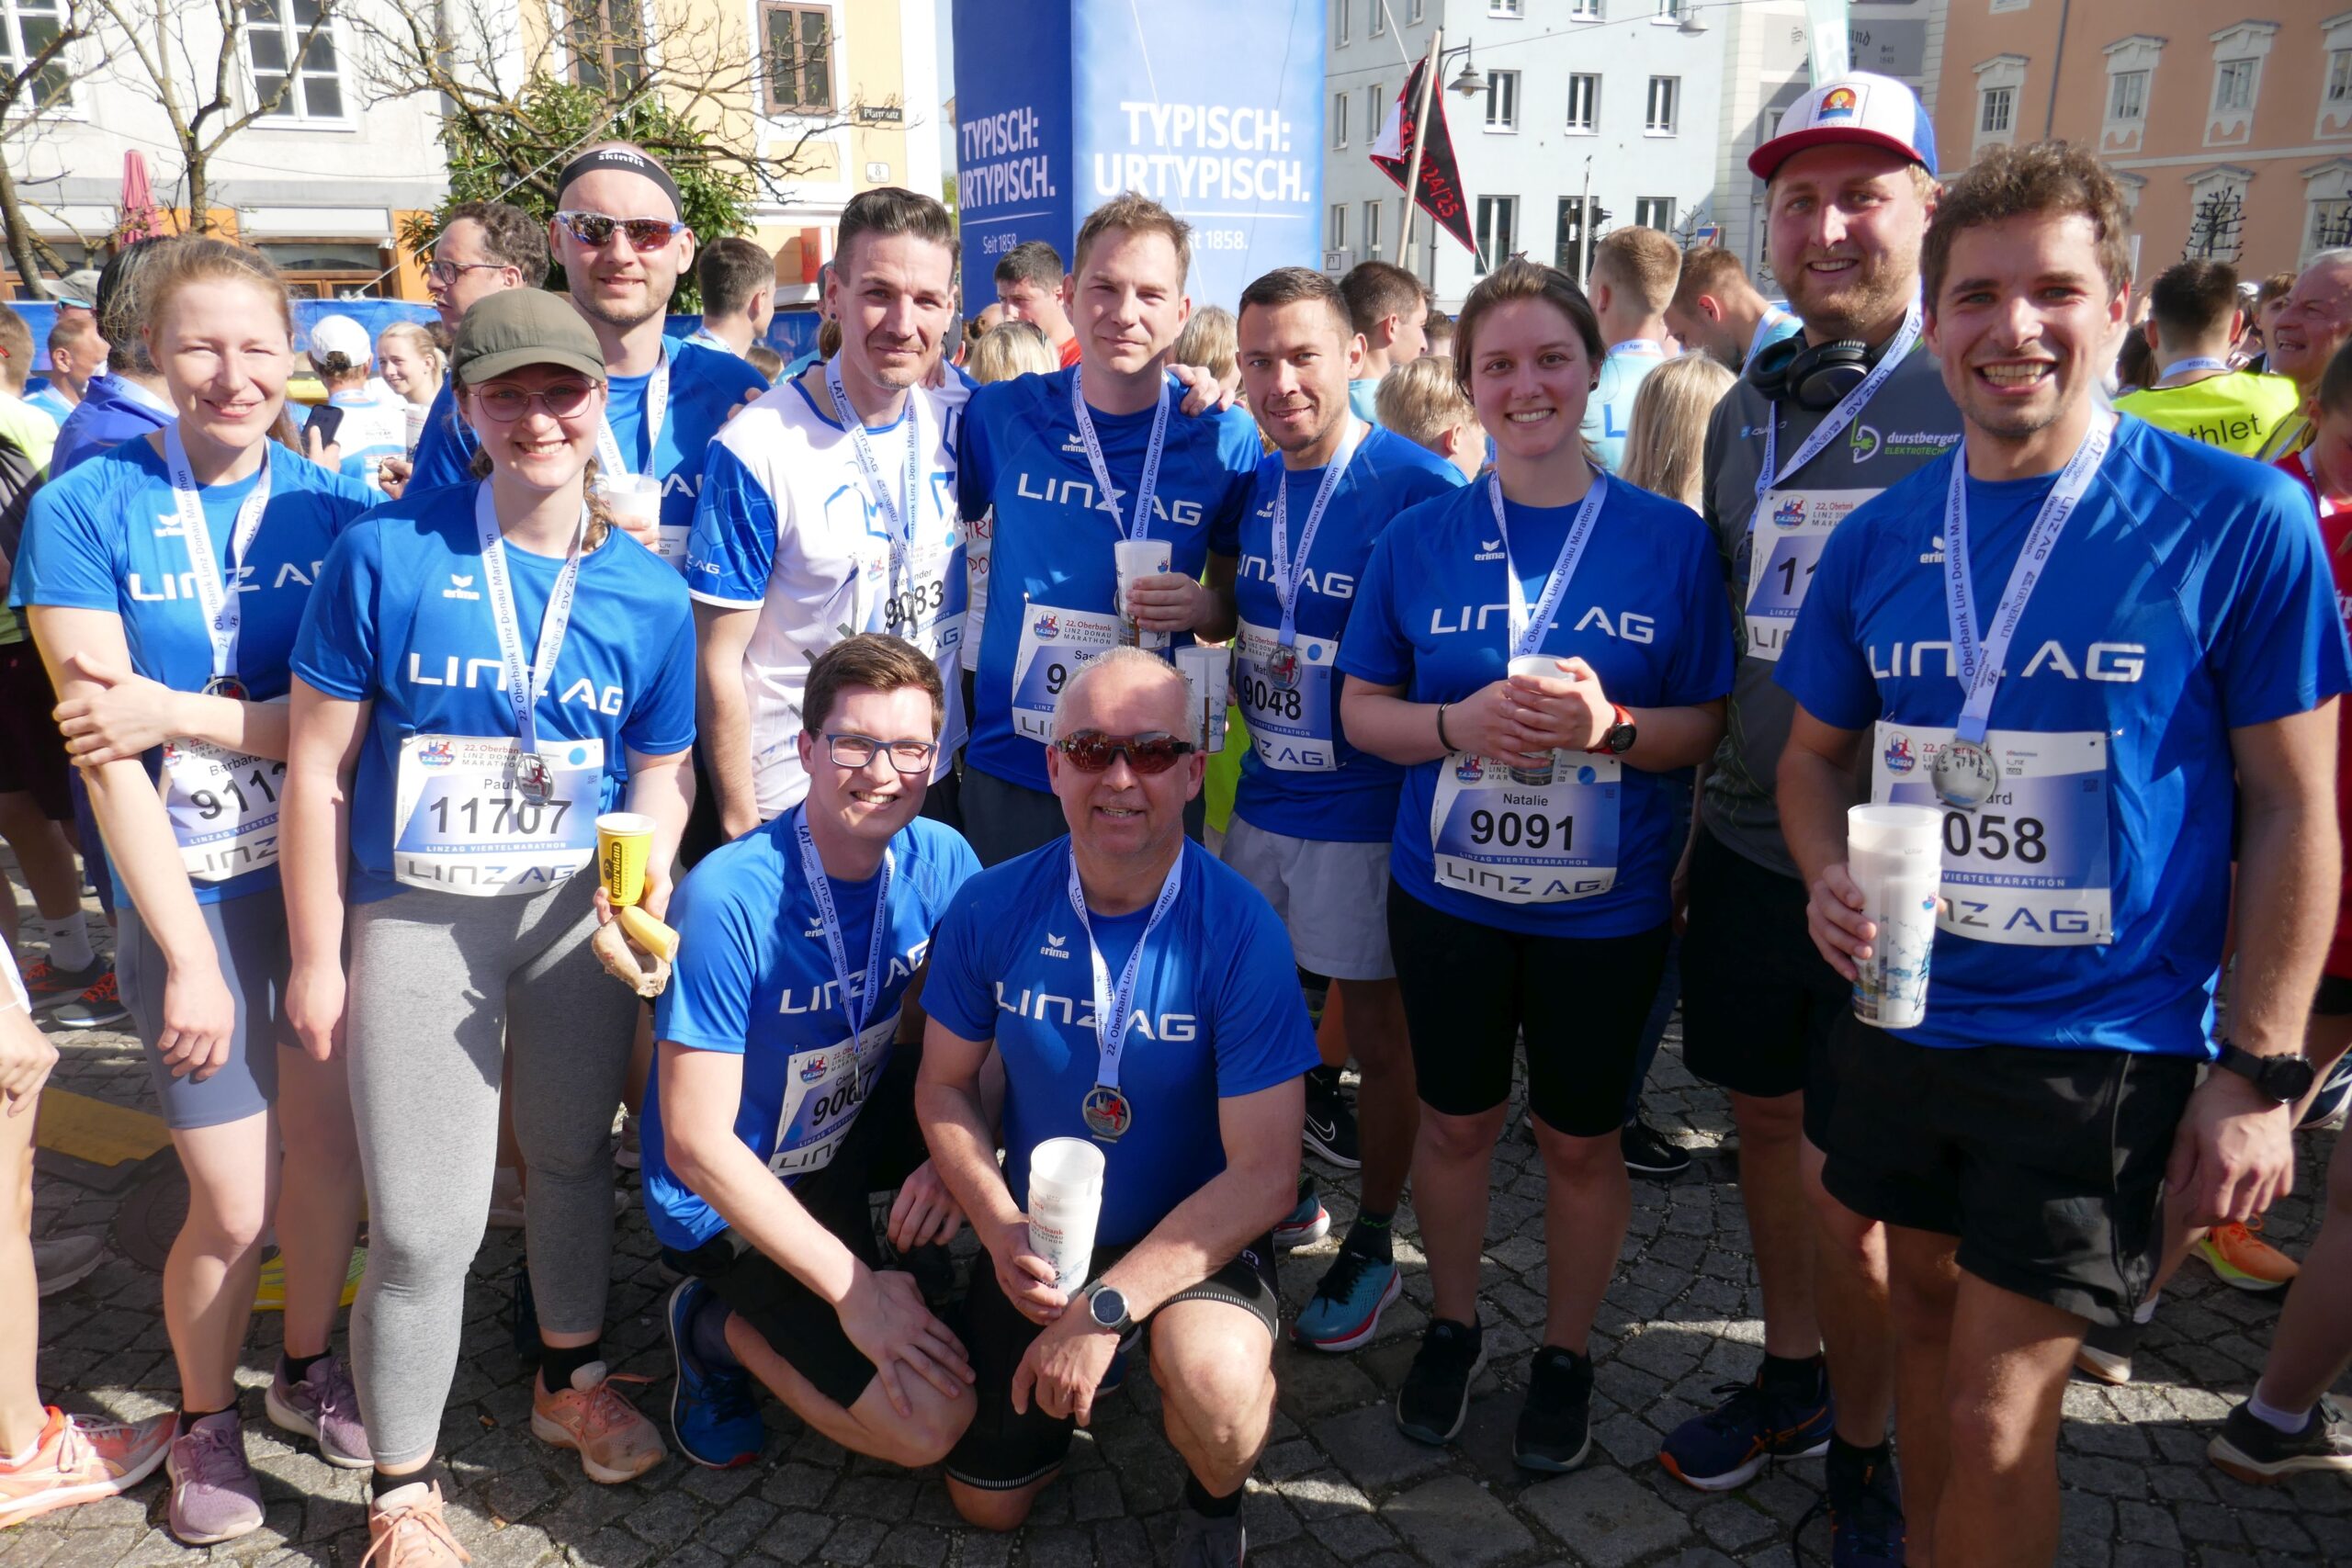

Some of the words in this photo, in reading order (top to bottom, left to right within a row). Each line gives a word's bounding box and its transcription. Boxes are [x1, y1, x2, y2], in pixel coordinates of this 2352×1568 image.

[962, 107, 1039, 163] TYPISCH:
[1120, 102, 1291, 152] TYPISCH:
[598, 153, 645, 167] skinfit
[957, 155, 1056, 210] URTYPISCH.
[1094, 153, 1311, 202] URTYPISCH.
[983, 235, 998, 254] Seit
[1205, 231, 1249, 251] 1858.
[906, 405, 914, 448] Marathon
[1083, 416, 1095, 441] LINZ
[1091, 443, 1102, 459] AG
[1154, 406, 1168, 447] Marathon
[1886, 432, 1962, 446] durstberger
[2173, 413, 2263, 446] thlet
[855, 428, 872, 456] LINZ
[868, 456, 879, 472] AG
[908, 451, 916, 480] Donau
[1148, 448, 1159, 478] Donau
[177, 469, 197, 521] Marathon
[1144, 478, 1154, 495] Linz
[881, 487, 899, 523] GENERALI
[1136, 497, 1150, 538] Oberbank
[1150, 492, 1204, 526] AG
[1278, 507, 1285, 525] AG
[1950, 477, 1961, 536] Marathon
[2047, 496, 2075, 535] LINZ
[192, 522, 206, 555] Donau
[1288, 560, 1302, 605] Oberbank
[1300, 540, 1309, 559] Linz
[1305, 509, 1320, 539] Donau
[1316, 467, 1340, 509] Marathon
[2023, 495, 2060, 555] Viertelmarathon
[486, 534, 503, 587] Marathon
[1279, 541, 1287, 575] GENERALI
[1474, 551, 1506, 561] erima
[1951, 539, 1962, 581] Donau
[2034, 536, 2052, 561] AG
[200, 557, 212, 581] Linz
[1298, 567, 1355, 599] AG
[1527, 597, 1554, 643] Oberbank
[1548, 576, 1563, 598] Linz
[1556, 546, 1577, 576] Donau
[1570, 502, 1595, 547] Marathon
[205, 581, 224, 630] Oberbank
[496, 589, 511, 624] Donau
[560, 591, 571, 610] AG
[884, 580, 944, 629] 9083
[1954, 582, 1965, 610] Linz
[2000, 587, 2030, 639] GENERALI
[1063, 634, 1112, 645] MARATHON
[1065, 619, 1076, 627] 22.
[1077, 621, 1112, 632] Oberbank
[1084, 629, 1112, 638] DONAU
[1254, 636, 1279, 647] Oberban
[1573, 605, 1656, 645] AG
[1955, 611, 1975, 677] Oberbank
[2020, 639, 2146, 683] AG
[507, 651, 525, 704] Oberbank
[519, 705, 527, 721] 22.
[560, 678, 624, 716] AG
[1243, 675, 1302, 720] 9048
[1253, 719, 1311, 737] VIERTELMARATHON
[209, 753, 261, 776] Barbara
[480, 744, 522, 755] Oberban
[1278, 747, 1325, 766] AG
[1885, 758, 1913, 768] 7.4.2024
[1922, 742, 1939, 754] 22.
[483, 778, 517, 791] Paul
[1503, 793, 1549, 807] Natalie
[429, 796, 572, 835] 11707
[1470, 809, 1575, 852] 9091
[469, 841, 567, 852] VIERTELMARATHON
[799, 825, 813, 846] LAT
[1942, 811, 2047, 864] 058
[408, 860, 508, 886] LINZ
[517, 864, 577, 886] AG
[612, 845, 622, 896] peeroton
[805, 845, 816, 872] Nitrogen
[1496, 856, 1589, 867] VIERTELMARATHON
[1446, 862, 1532, 896] LINZ
[1943, 872, 2066, 888] VIERTELMARATHON
[809, 880, 828, 925] Viertelmarathon
[816, 875, 832, 905] LINZ
[826, 906, 836, 924] AG
[1147, 881, 1177, 929] Marathon
[876, 902, 886, 936] Donau
[2003, 906, 2089, 934] AG
[834, 942, 847, 977] GENERALI
[873, 936, 882, 959] Linz
[1040, 946, 1069, 960] erima
[866, 959, 877, 1007] Oberbank
[1125, 963, 1135, 986] Linz
[995, 981, 1097, 1030] LINZ
[1125, 1009, 1197, 1043] AG
[1111, 986, 1129, 1040] Oberbank
[1106, 1040, 1118, 1057] 22.
[801, 1069, 826, 1081] 7.4.2024
[812, 1066, 877, 1127] 9067
